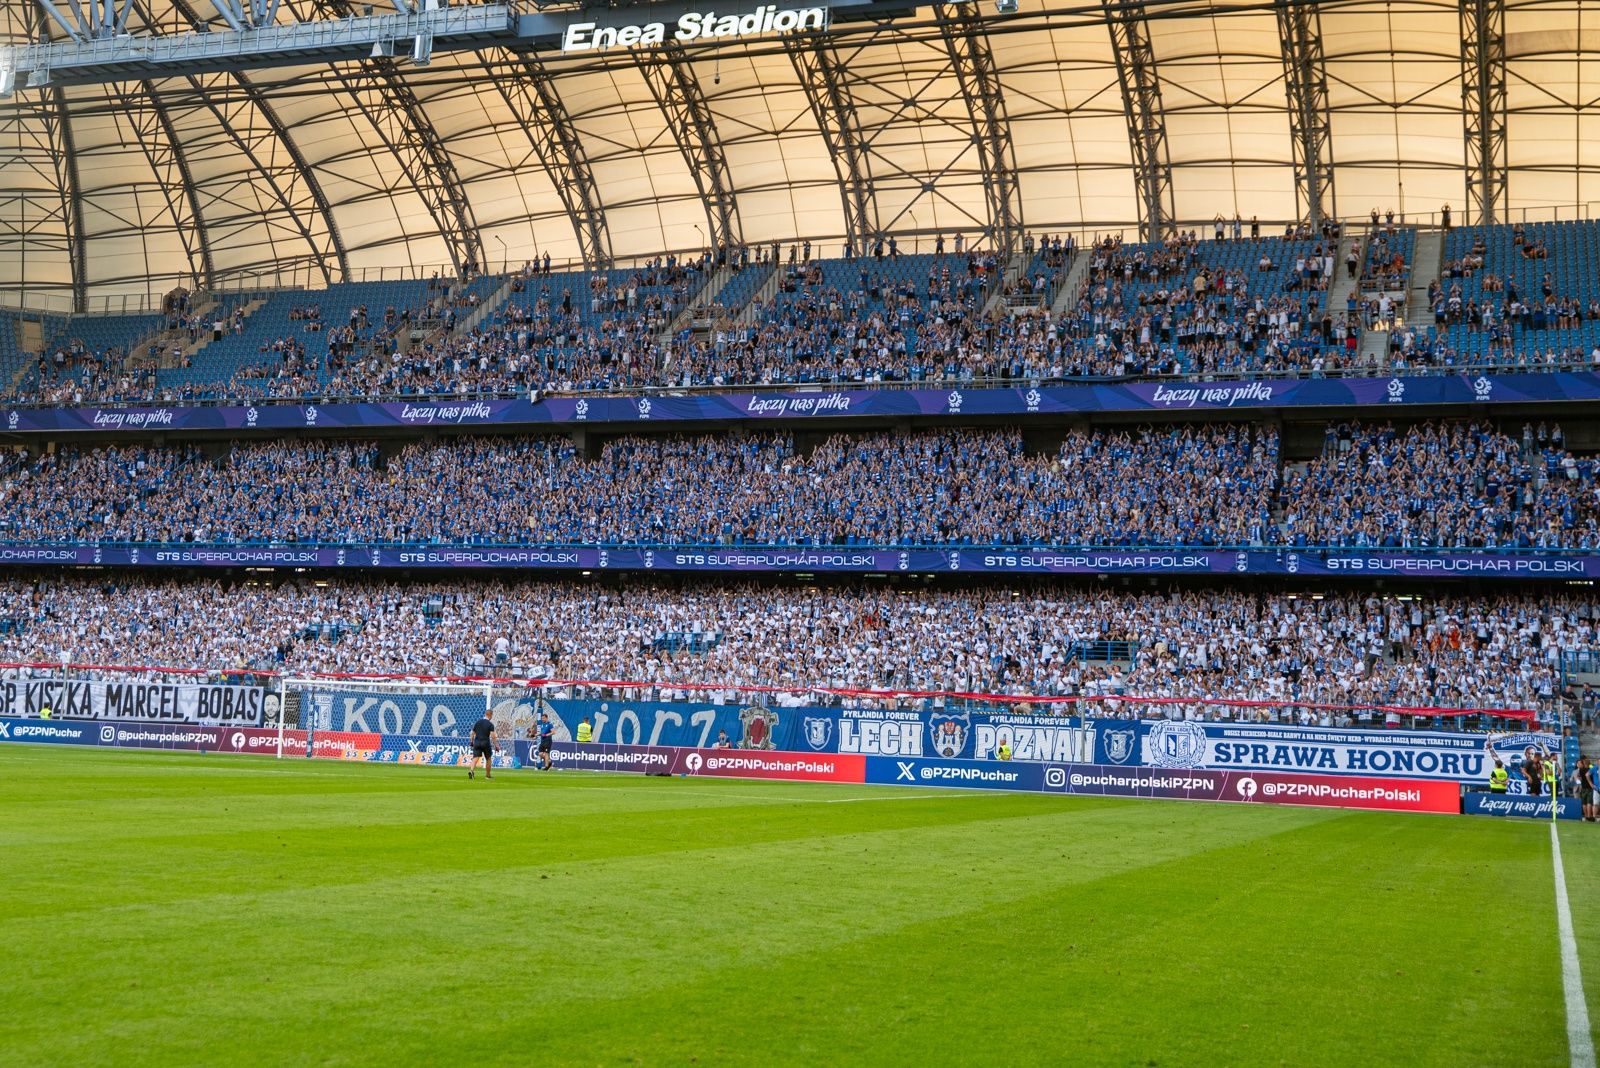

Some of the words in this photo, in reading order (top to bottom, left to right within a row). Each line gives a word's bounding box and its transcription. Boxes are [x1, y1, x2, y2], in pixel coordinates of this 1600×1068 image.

[563, 22, 665, 51] Enea
[674, 4, 823, 41] Stadion
[37, 550, 77, 559] POLSKI
[156, 552, 180, 561] STS
[182, 552, 273, 561] SUPERPUCHAR
[275, 553, 318, 562] POLSKI
[399, 553, 426, 562] STS
[428, 553, 528, 562] SUPERPUCHAR
[530, 553, 578, 563] POLSKI
[675, 555, 705, 565] STS
[707, 555, 819, 566] SUPERPUCHAR
[822, 555, 875, 566] POLSKI
[984, 556, 1017, 566] STS
[1020, 556, 1145, 567] SUPERPUCHAR
[1149, 556, 1209, 567] POLSKI
[1327, 558, 1364, 569] STS
[1368, 558, 1510, 571] SUPERPUCHAR
[1515, 560, 1584, 572] POLSKI
[105, 684, 190, 721] MARCEL,
[198, 687, 260, 720] BOBAS
[843, 710, 884, 720] PYRLANDIA
[885, 712, 920, 721] FOREVER
[989, 715, 1033, 725] PYRLANDIA
[1034, 717, 1070, 726] FOREVER
[14, 726, 82, 738] @PZPNPuchar
[117, 729, 217, 744] @pucharpolskiPZPN
[839, 720, 923, 756] LECH
[249, 736, 355, 750] @PZPNPucarPolski
[426, 744, 507, 757] @PZPNar
[550, 750, 668, 766] @pucharpolskiPZPN
[1214, 743, 1338, 769] SPRAWA
[1346, 749, 1484, 775] HONORU
[706, 758, 834, 774] @PZPNPucharPolski
[921, 767, 1019, 782] @PZPNPuchar
[1069, 773, 1214, 791] @pucharpolskiPZPN
[1262, 783, 1421, 802] @PZPNPucharPolski
[1479, 797, 1513, 814] Łączy
[1514, 801, 1535, 812] nas
